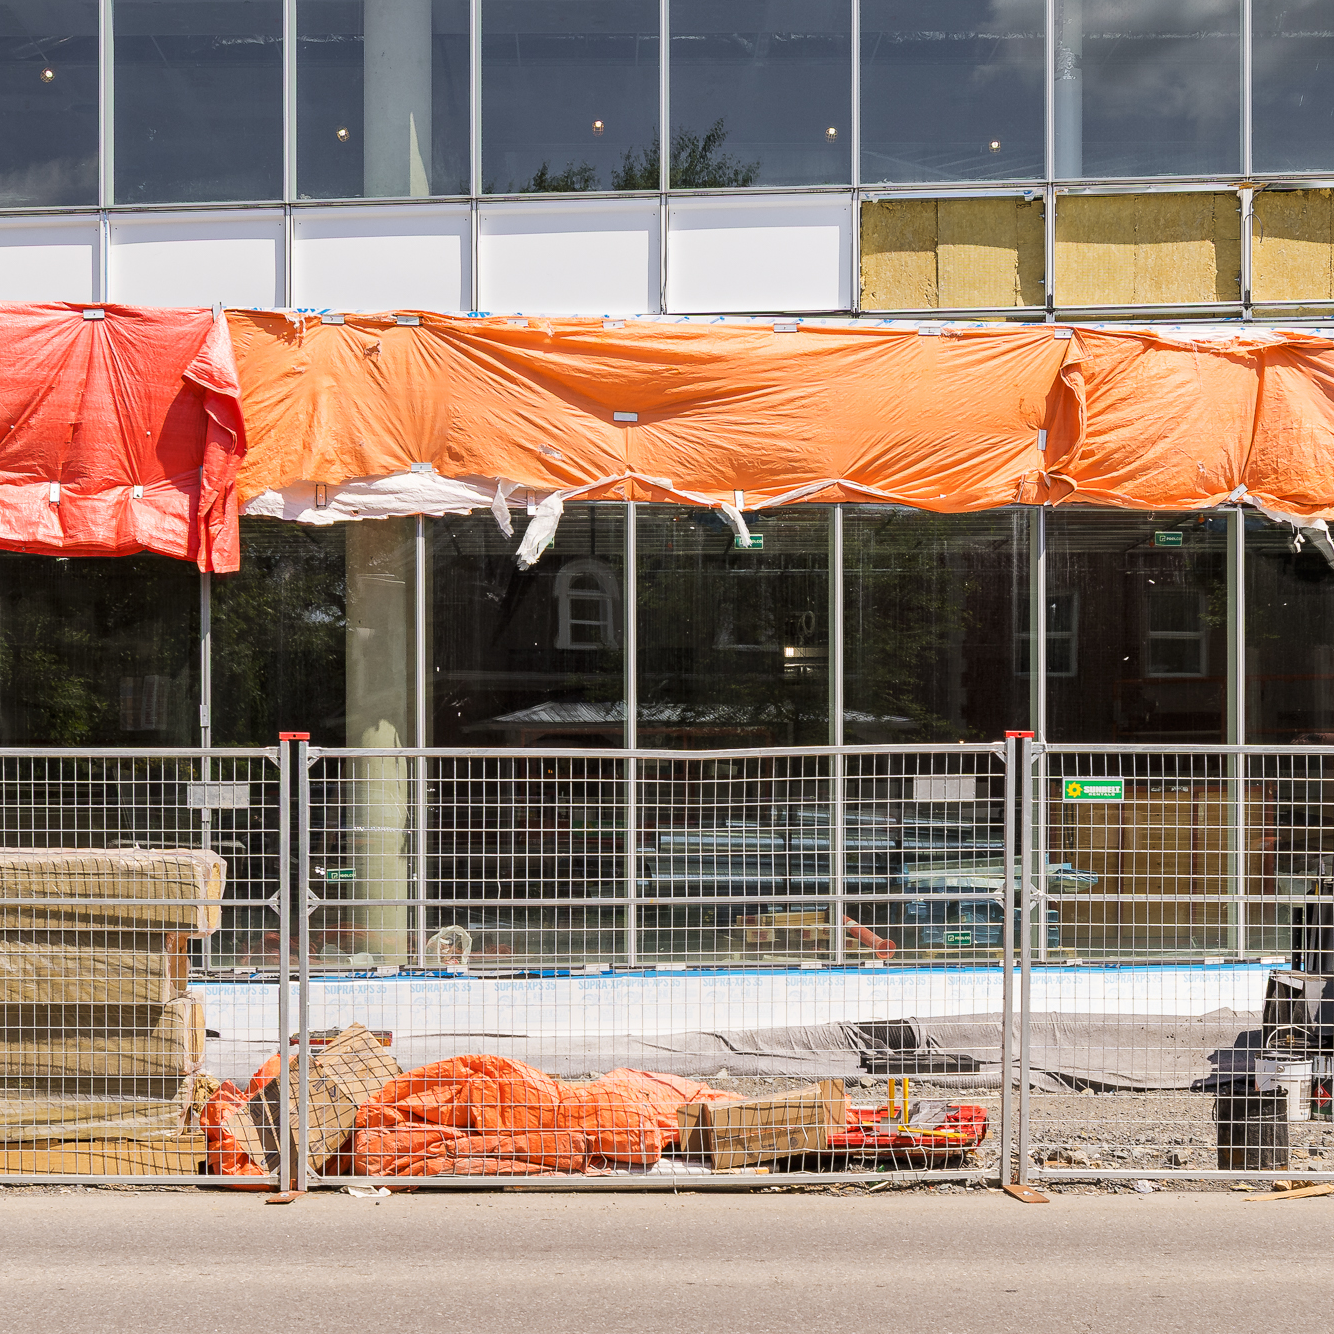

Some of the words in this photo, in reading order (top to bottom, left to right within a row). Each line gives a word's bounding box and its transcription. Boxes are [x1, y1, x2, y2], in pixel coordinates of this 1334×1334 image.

[670, 978, 681, 987] 35
[753, 977, 763, 987] 35
[835, 976, 845, 986] 35
[916, 976, 926, 986] 35
[993, 975, 1004, 985] 35
[1029, 975, 1071, 985] OPRA-XPS
[1073, 975, 1083, 984] 35
[1153, 974, 1163, 984] 35
[1231, 973, 1241, 983] 35
[258, 985, 270, 995] 35
[376, 983, 387, 994] 35
[461, 982, 472, 992] 35
[545, 980, 556, 991] 35
